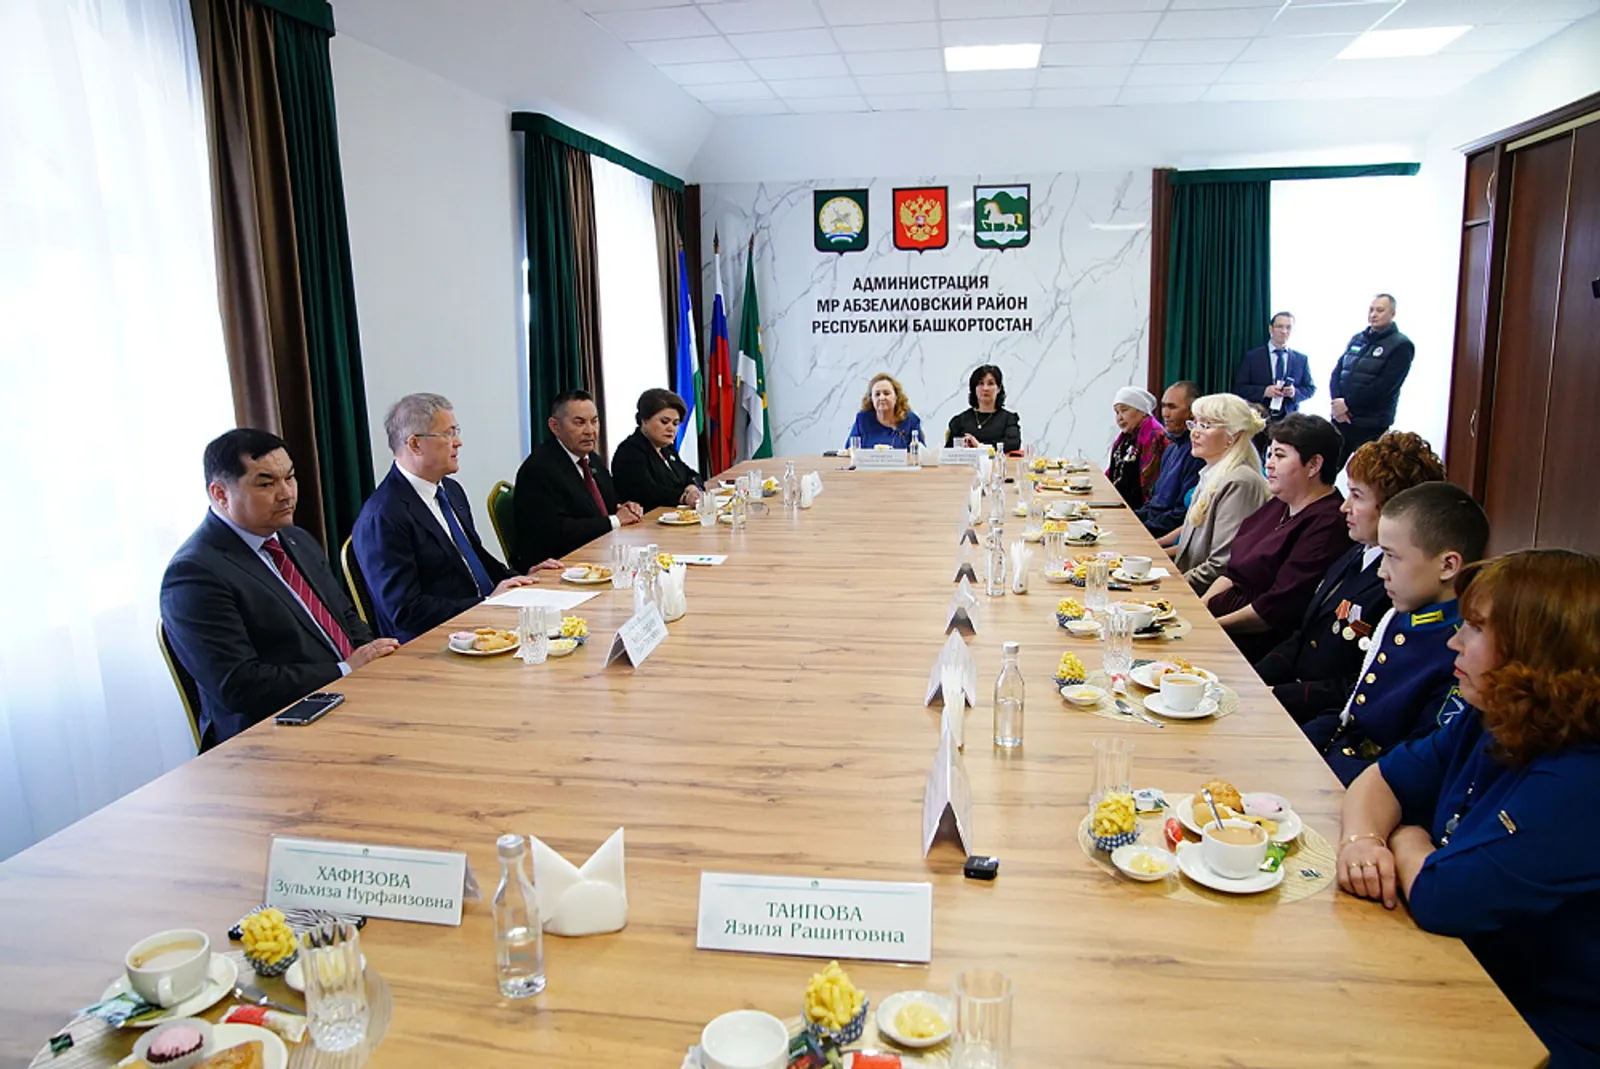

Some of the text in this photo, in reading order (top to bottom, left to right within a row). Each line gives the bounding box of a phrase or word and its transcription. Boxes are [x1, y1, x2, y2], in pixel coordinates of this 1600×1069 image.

[852, 276, 988, 292] АДМИНИСТРАЦИЯ
[817, 293, 1028, 313] МР АБЗЕЛИЛОВСКИЙ РАЙОН
[812, 317, 1033, 334] РЕСПУБЛИКИ БАШКОРТОСТАН
[316, 866, 411, 889] ХАФИЗОВА
[274, 879, 342, 897] Зульхиза
[766, 901, 863, 922] ТАИПОВА
[723, 919, 905, 943] Язиля Рашитовна
